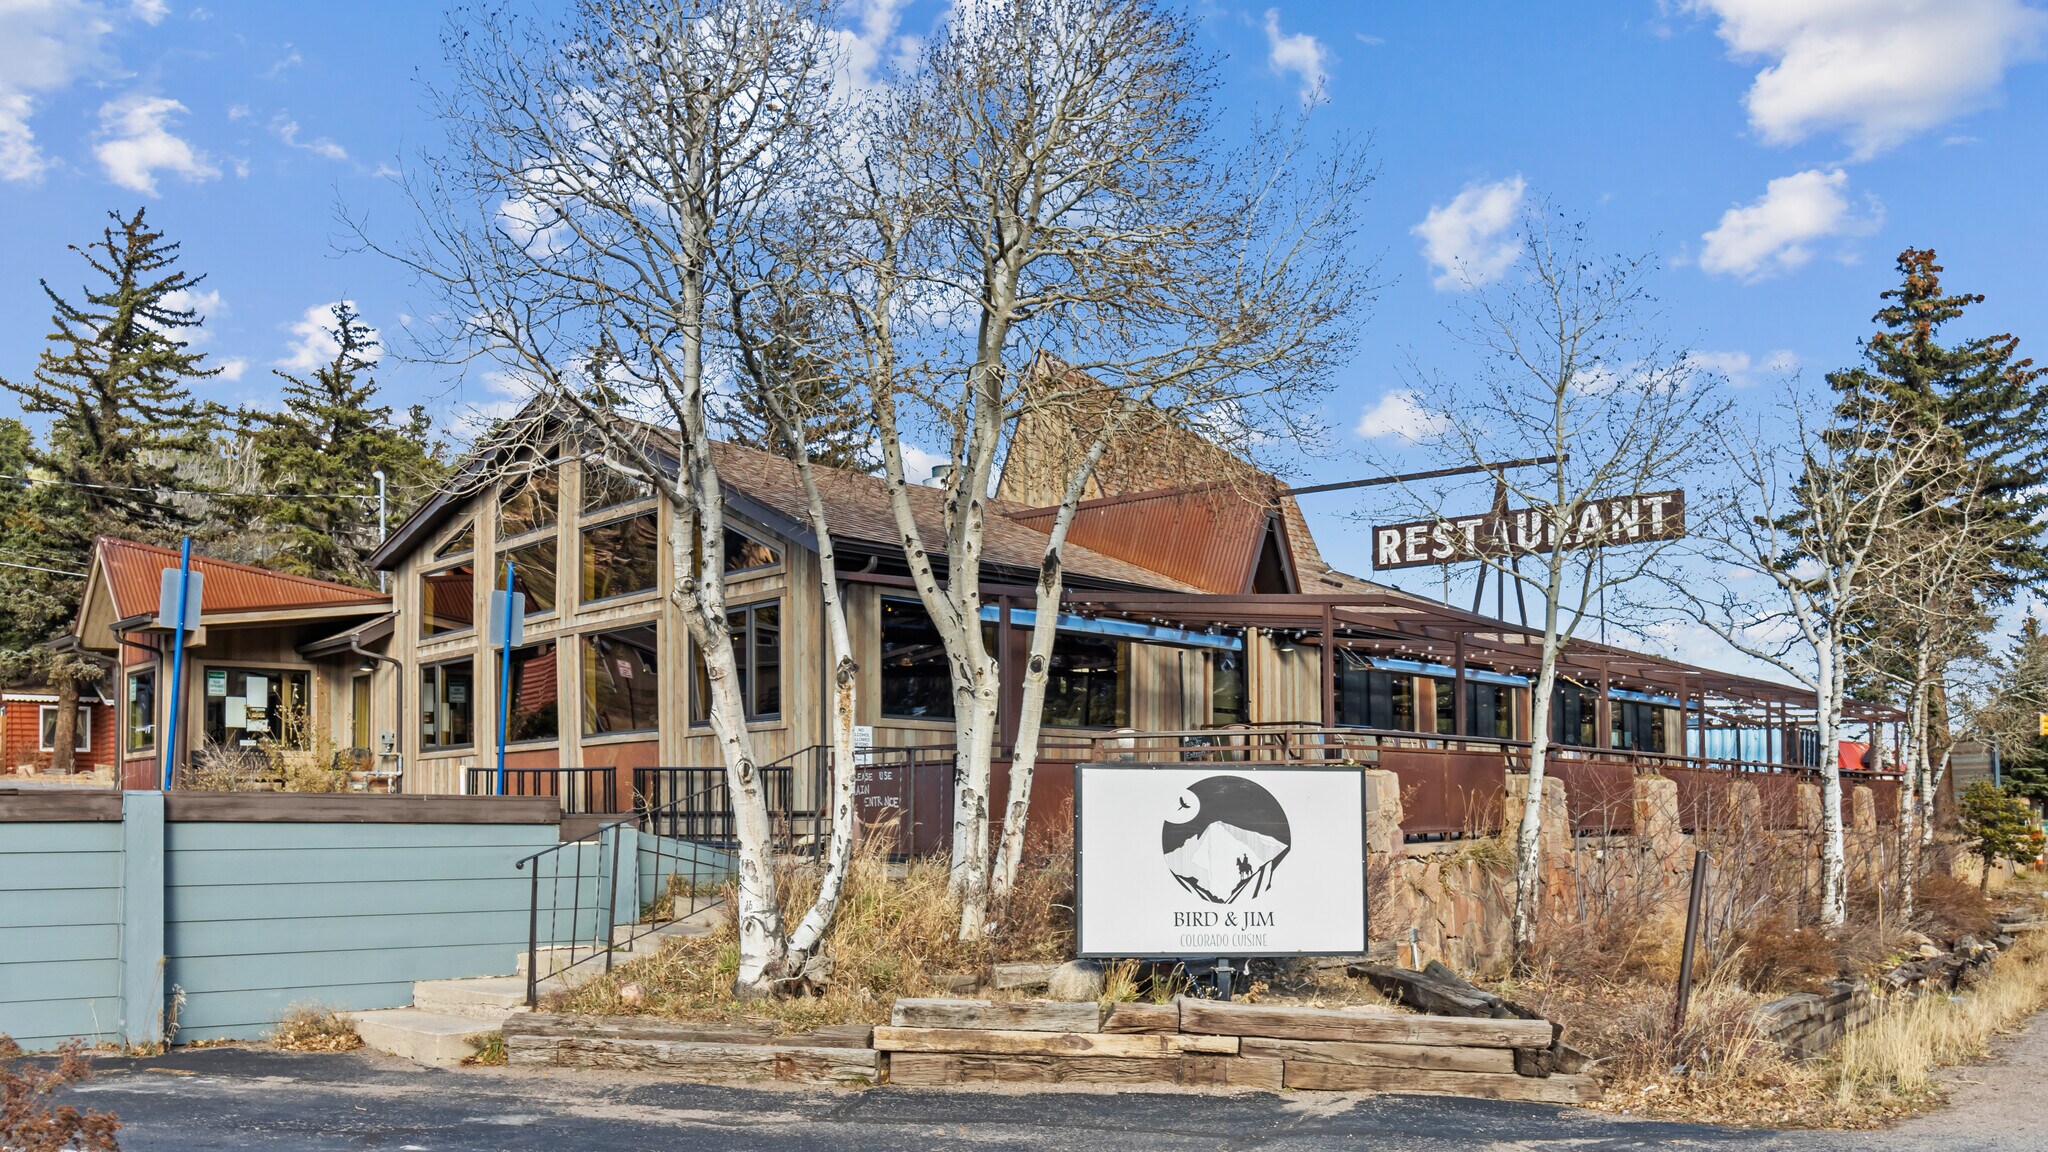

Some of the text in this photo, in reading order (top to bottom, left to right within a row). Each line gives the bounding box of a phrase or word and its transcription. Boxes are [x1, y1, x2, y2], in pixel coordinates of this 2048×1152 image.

[855, 771, 893, 781] LEASE USE
[855, 784, 870, 795] AIN
[864, 795, 899, 808] ENTRNCE
[1173, 911, 1275, 931] BIRD & JIM
[1180, 934, 1269, 947] COLORADO CUISINE
